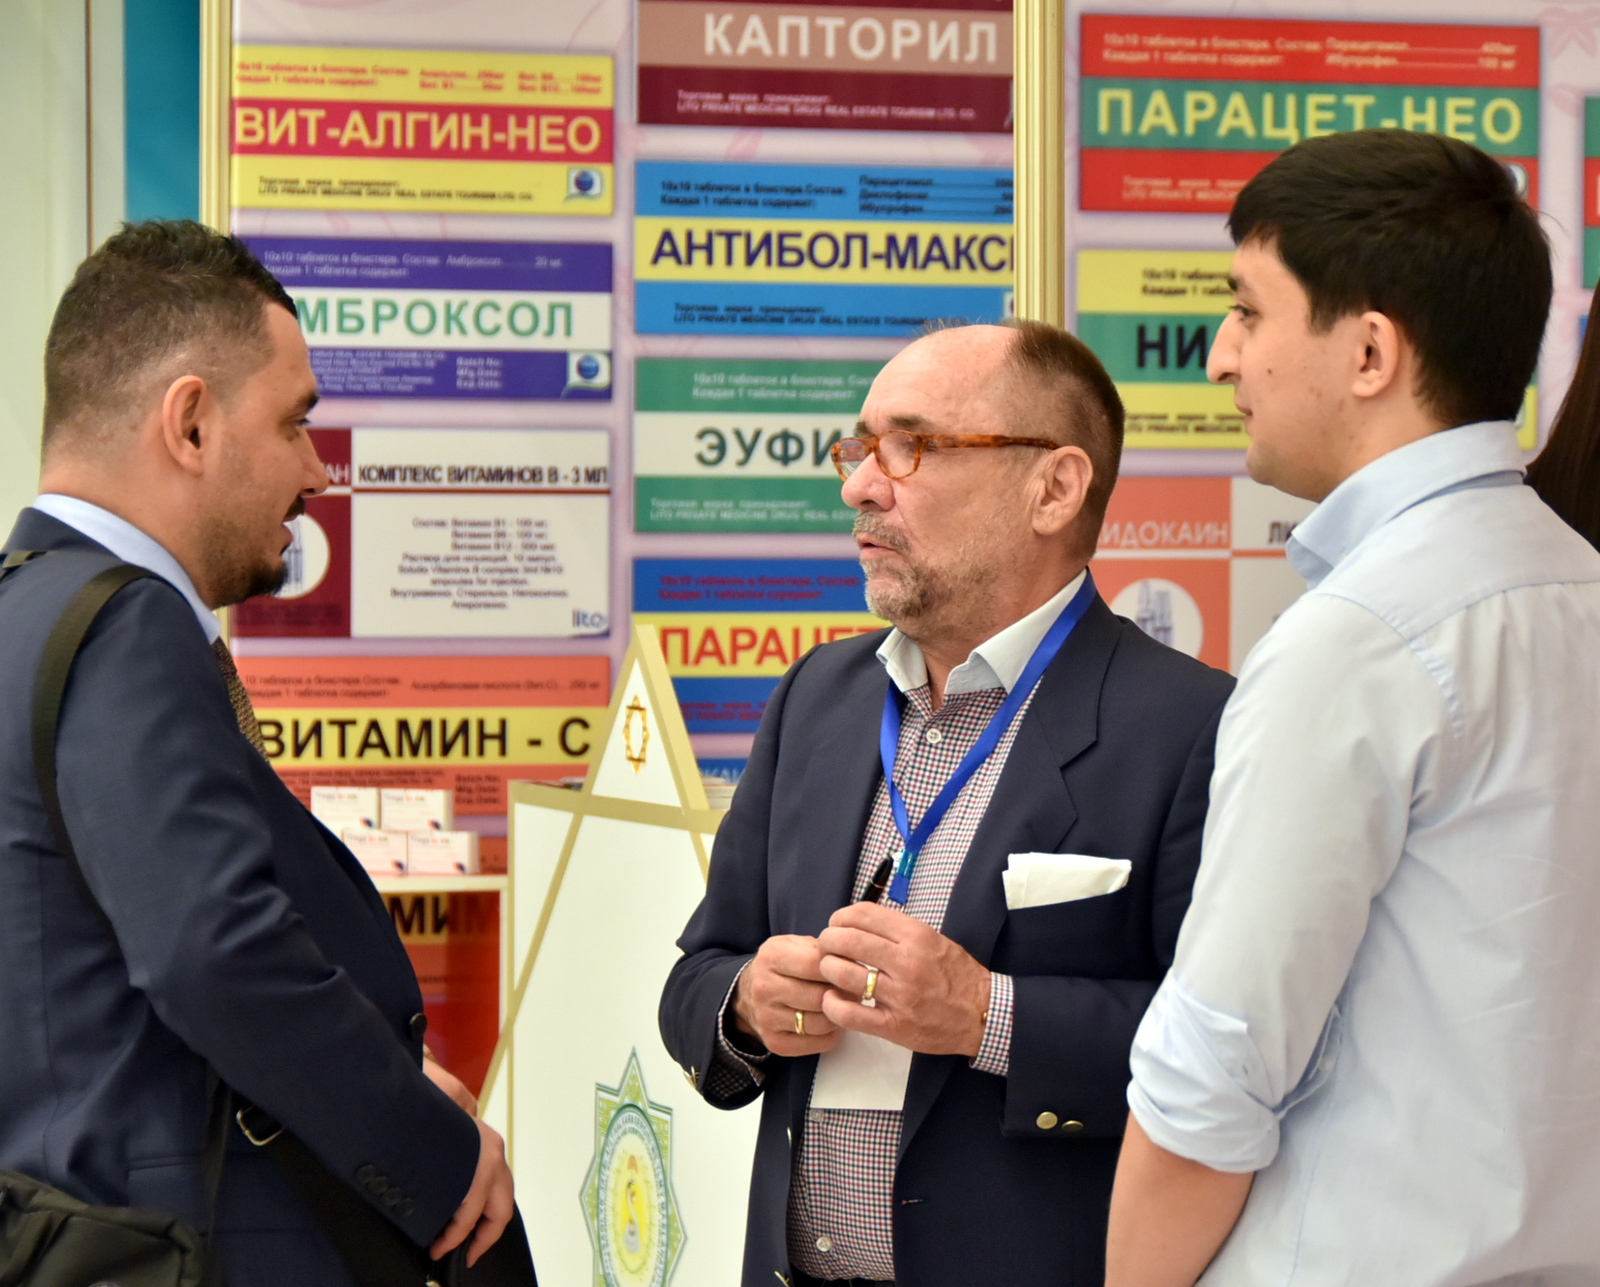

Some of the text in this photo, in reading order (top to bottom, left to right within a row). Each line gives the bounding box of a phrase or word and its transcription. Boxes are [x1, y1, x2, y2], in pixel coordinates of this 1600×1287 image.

[703, 12, 998, 63] КАПТОРИЛ
[234, 106, 602, 154] ВИТ-АЛГИН-НЕО
[1097, 87, 1523, 145] ПАРАЦЕТ-НЕО
[650, 227, 1013, 272] АНТИБОЛ-МАКС
[296, 297, 573, 338] МБРОКСОЛ
[1136, 322, 1208, 370] НИ
[694, 426, 843, 468] ЭУФИ
[358, 464, 443, 483] КОМПЛЕКС
[447, 465, 543, 483] ВИТАМИНОВ
[1098, 520, 1229, 547] ИДОКАИН
[259, 717, 507, 759] ВИТАМИН
[558, 716, 591, 758] С
